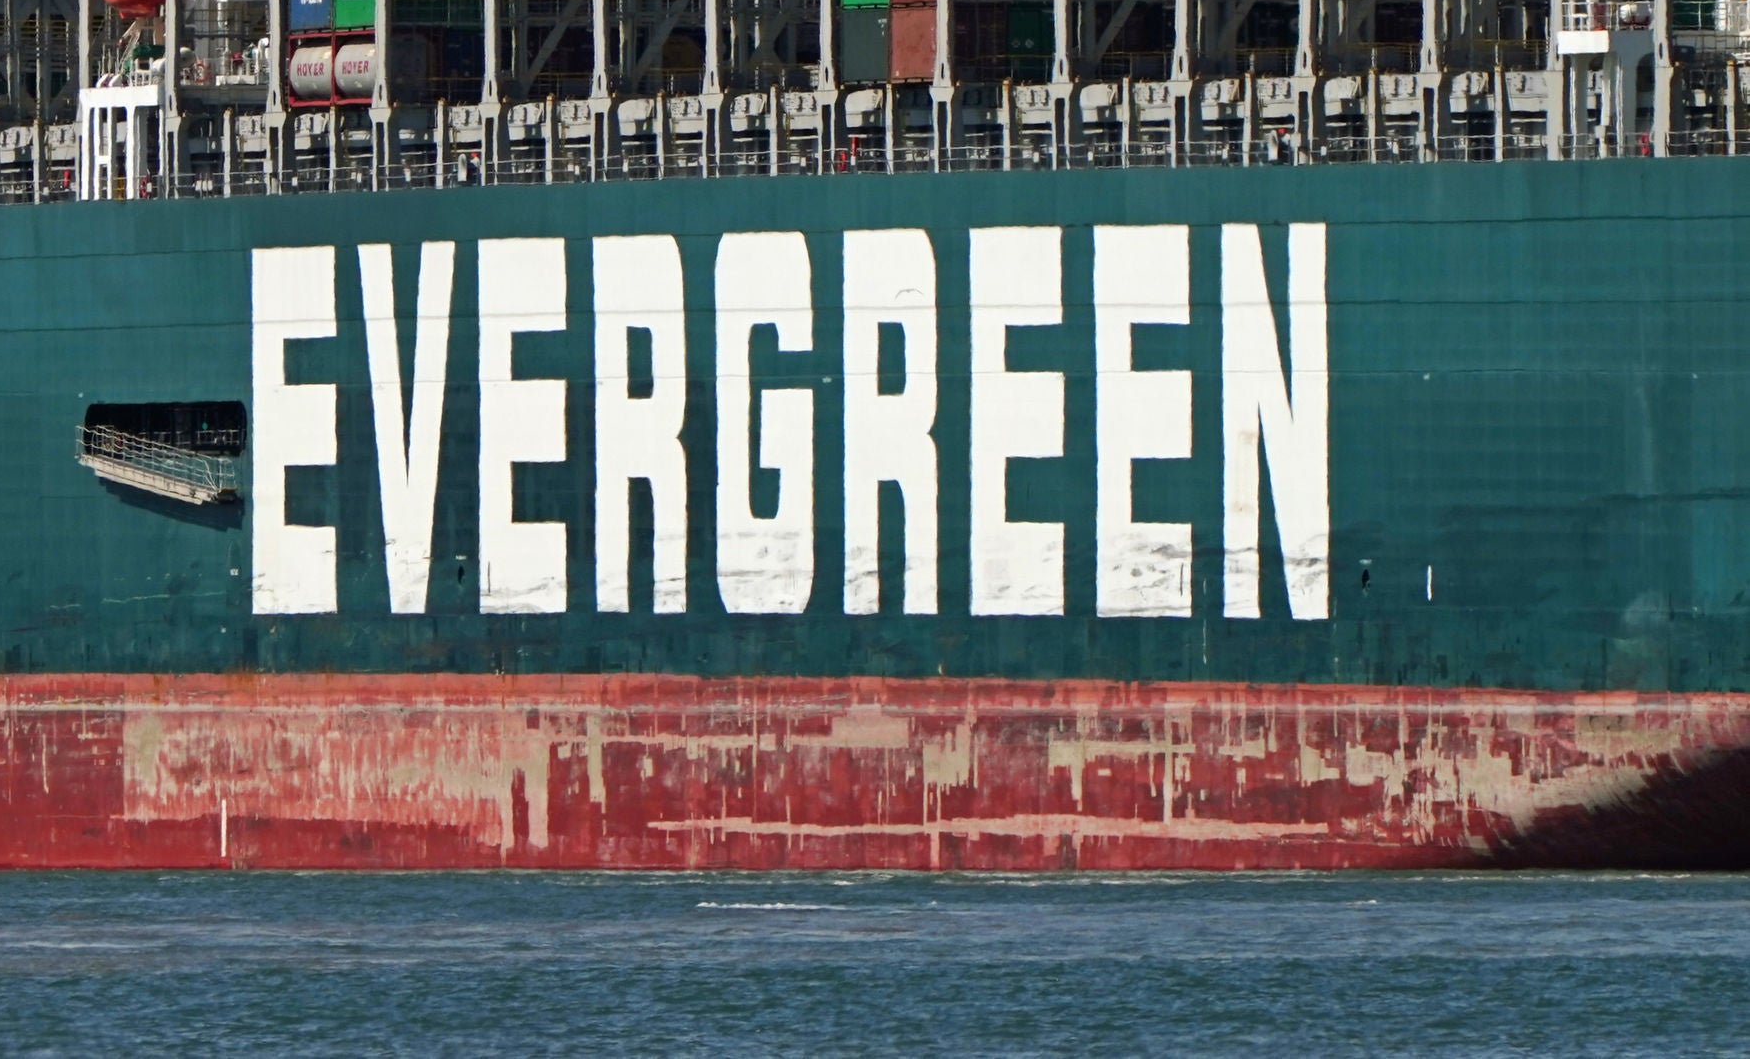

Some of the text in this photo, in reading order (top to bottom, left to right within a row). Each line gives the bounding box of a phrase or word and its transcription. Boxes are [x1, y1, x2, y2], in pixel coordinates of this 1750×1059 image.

[296, 62, 325, 77] HOYER
[341, 60, 370, 75] HOYER
[250, 222, 1330, 621] EVERGREEN
